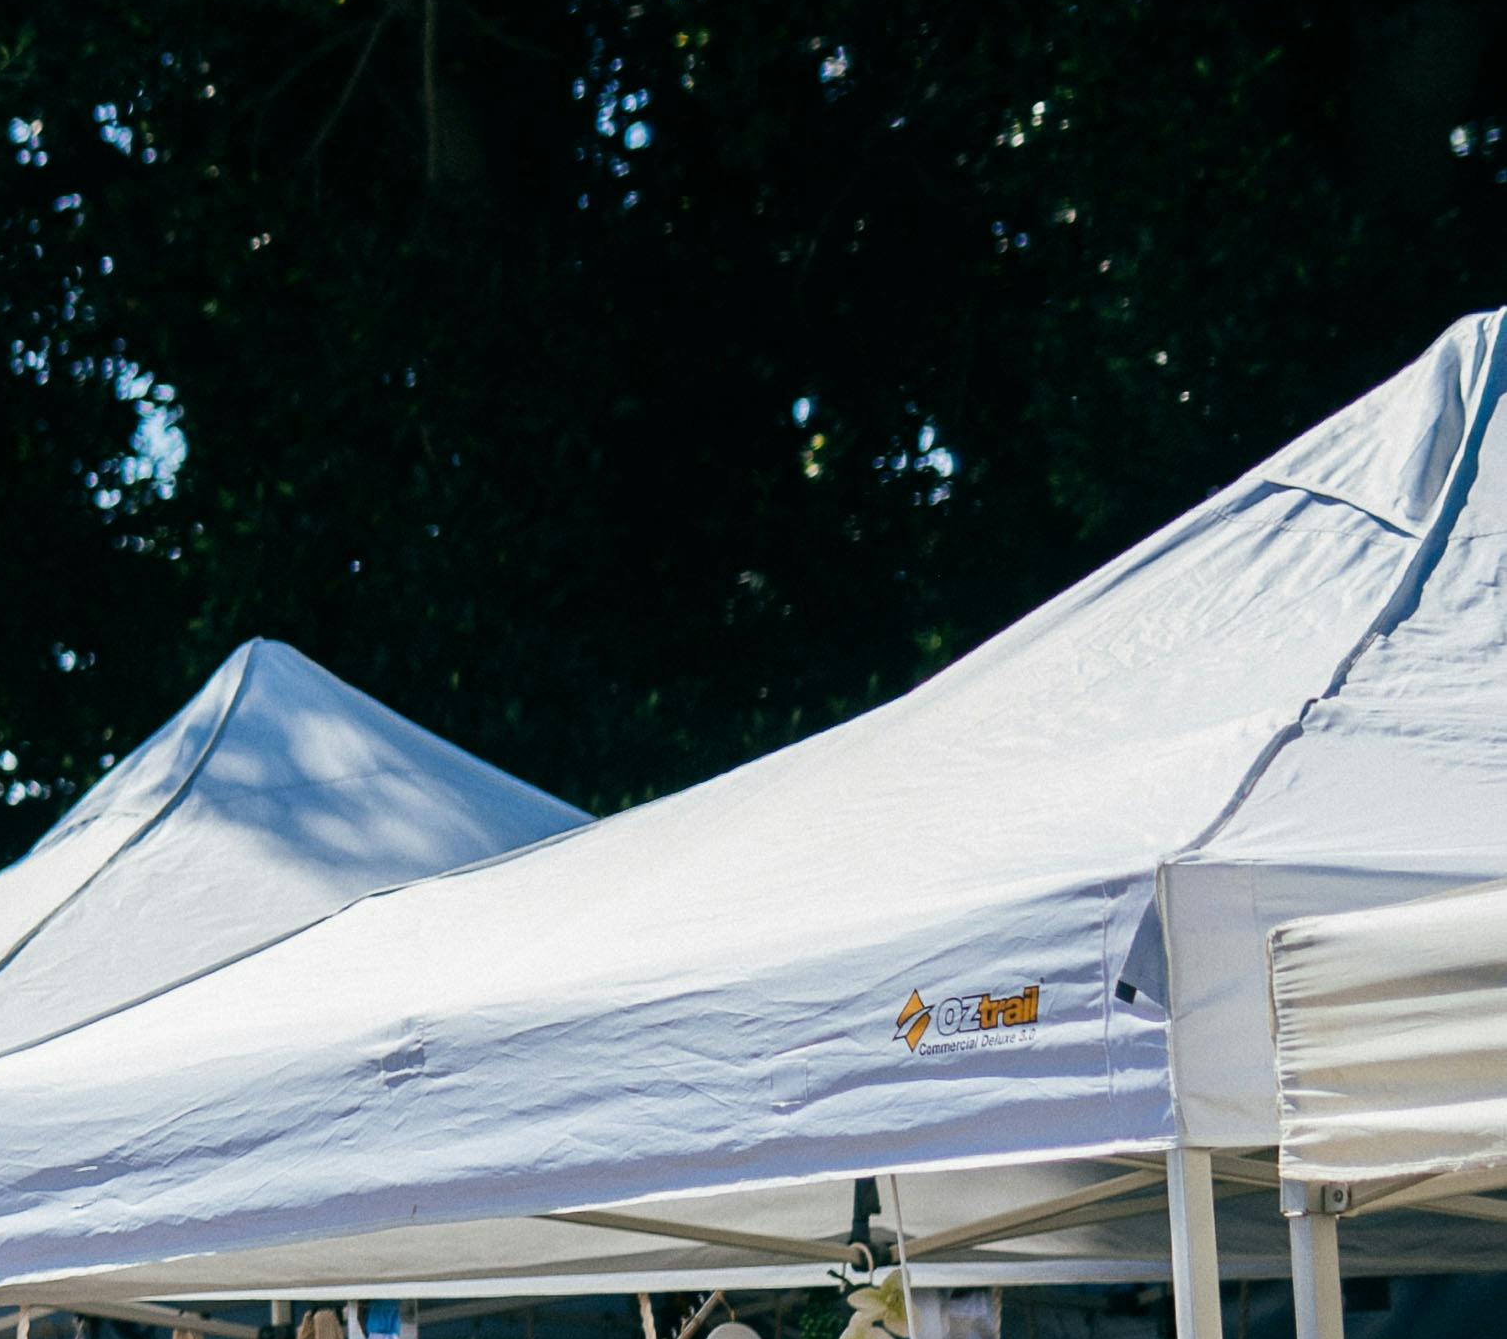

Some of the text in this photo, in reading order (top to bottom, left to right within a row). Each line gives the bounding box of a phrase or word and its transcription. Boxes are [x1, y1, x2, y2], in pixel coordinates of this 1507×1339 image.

[937, 985, 1040, 1036] OZtrail
[919, 1036, 978, 1056] Commercial
[981, 1033, 1016, 1047] Deluxe
